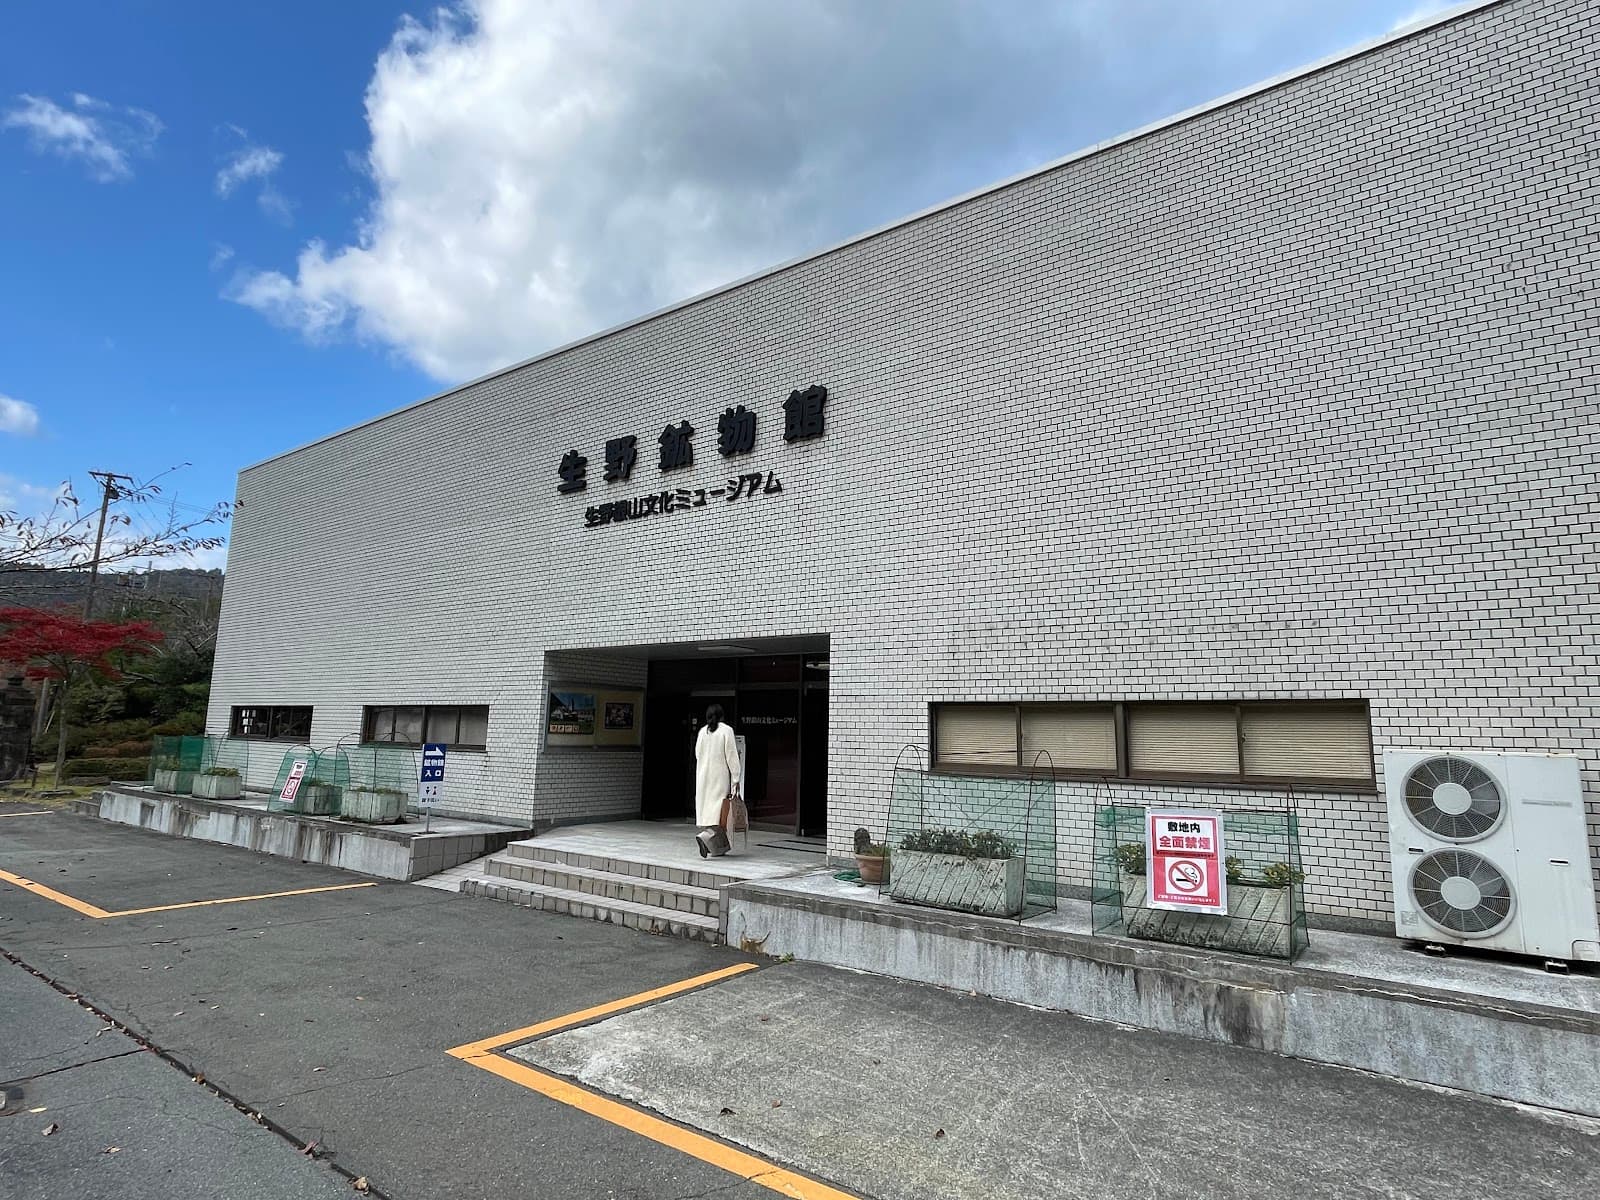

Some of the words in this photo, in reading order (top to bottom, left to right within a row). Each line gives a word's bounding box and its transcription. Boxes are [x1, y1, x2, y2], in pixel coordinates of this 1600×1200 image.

[557, 384, 827, 494] 生野鉱物館
[424, 769, 442, 777] 入口
[1167, 821, 1201, 833] 敷地内
[1159, 835, 1211, 850] 全面禁煙
